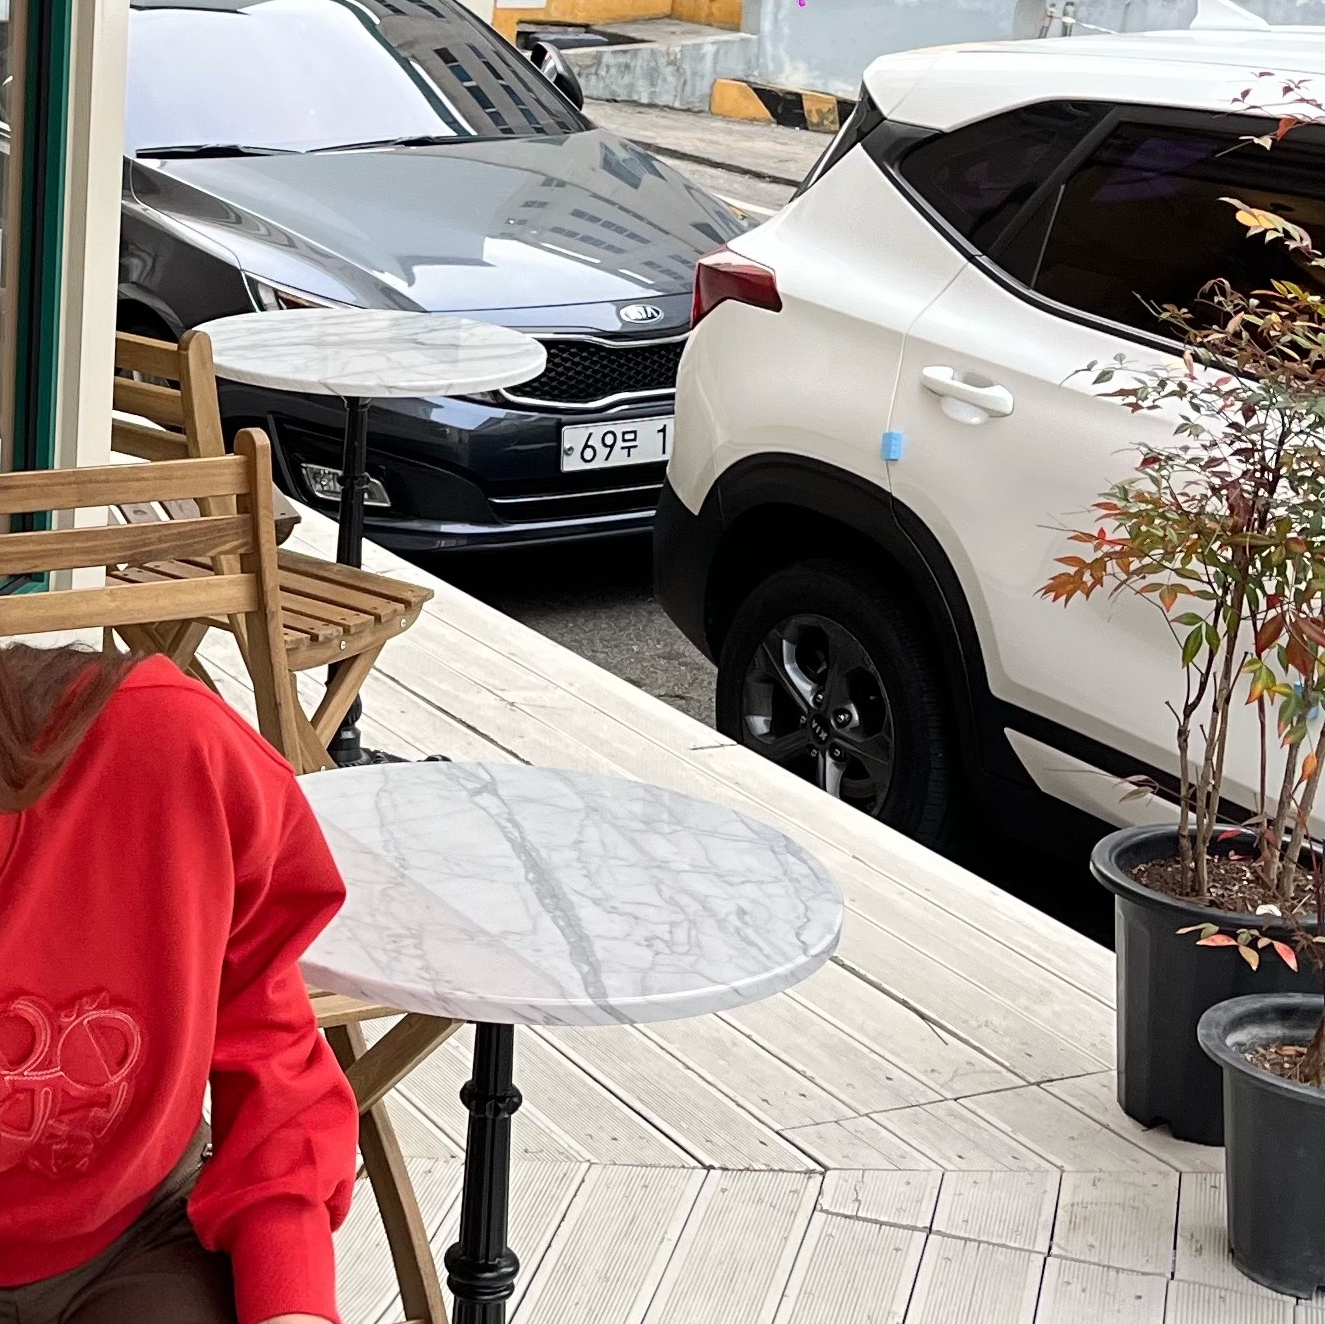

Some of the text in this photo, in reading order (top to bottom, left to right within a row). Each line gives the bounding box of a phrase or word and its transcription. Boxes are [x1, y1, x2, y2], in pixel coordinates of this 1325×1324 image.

[623, 305, 660, 321] KIA
[580, 430, 638, 463] 69무
[811, 718, 828, 741] KIA
